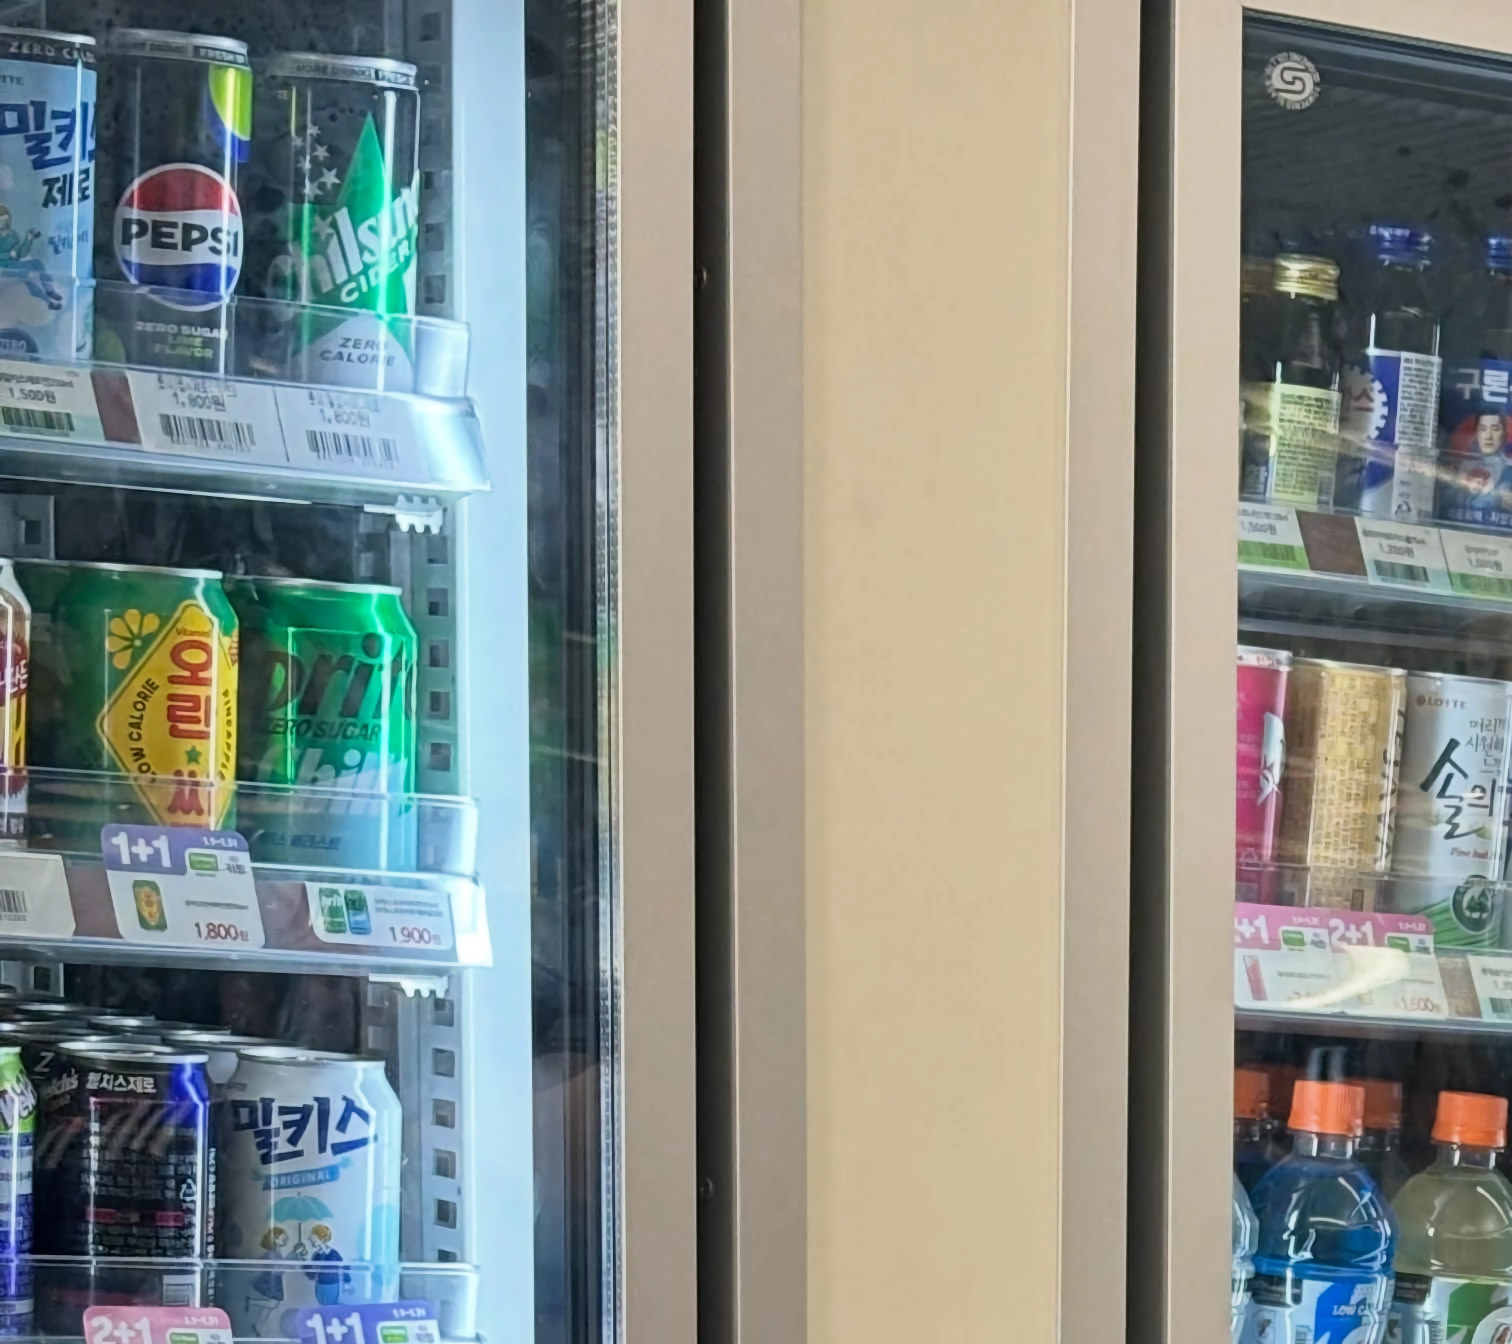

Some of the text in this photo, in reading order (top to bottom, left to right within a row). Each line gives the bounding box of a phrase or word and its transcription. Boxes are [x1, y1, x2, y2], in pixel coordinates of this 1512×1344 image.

[0, 99, 96, 171] 밀키
[121, 219, 239, 258] PEPSI
[128, 677, 160, 742] CALORIE
[111, 832, 172, 868] 1+1
[1233, 914, 1269, 945] +1
[233, 1094, 379, 1166] 밀키스
